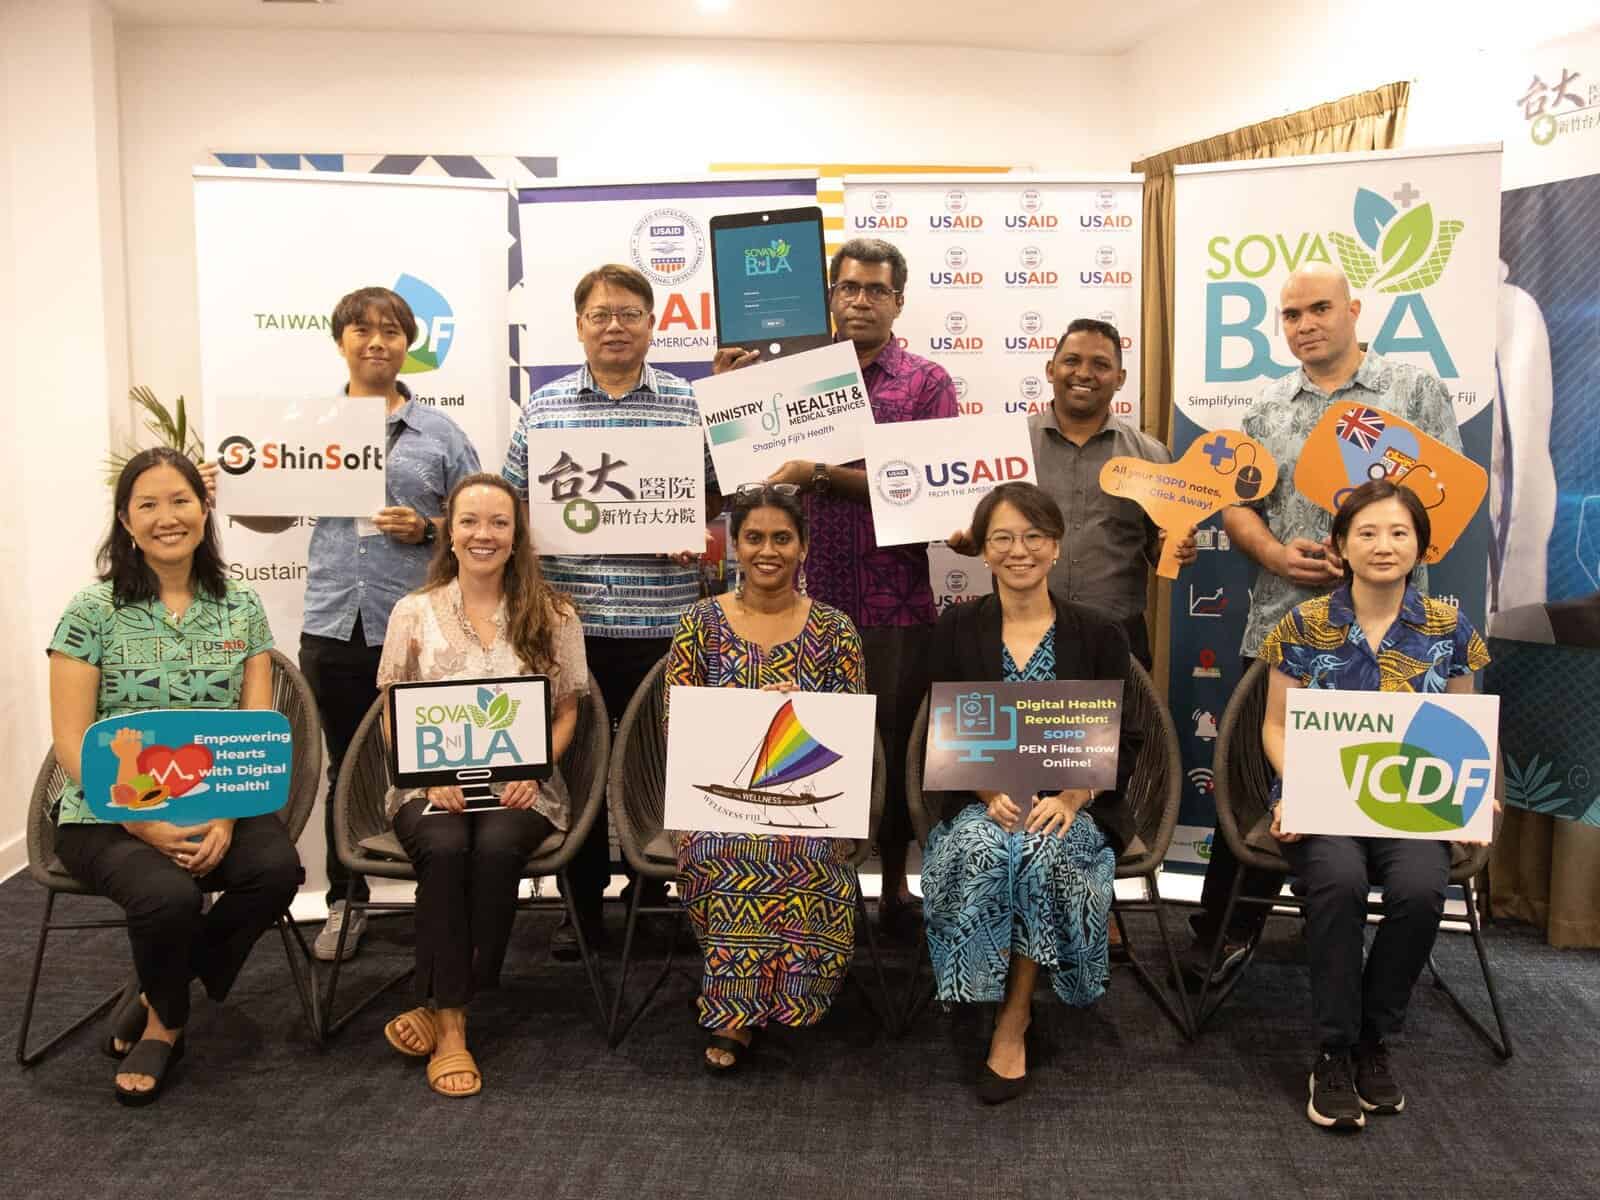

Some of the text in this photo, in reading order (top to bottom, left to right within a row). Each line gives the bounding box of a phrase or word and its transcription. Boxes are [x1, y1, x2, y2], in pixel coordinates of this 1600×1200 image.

[855, 216, 908, 228] USAID
[930, 216, 983, 228] USAID
[1005, 216, 1058, 228] USAID
[1080, 216, 1132, 228] USAID
[652, 227, 682, 235] USAID
[1206, 232, 1332, 280] SOVA
[930, 272, 983, 284] USAID
[1005, 272, 1058, 284] USAID
[1080, 272, 1132, 284] USAID
[650, 337, 709, 348] AMERICAN
[931, 337, 984, 350] USAID
[1005, 337, 1058, 350] USAID
[440, 394, 465, 406] and
[1188, 395, 1253, 408] Simplifying
[1457, 391, 1477, 405] Fiji
[705, 386, 863, 436] MINISTRY of HEALTH &
[789, 400, 866, 426] MEDICAL SERVICES
[753, 424, 835, 453] Shaping Fiji's Health
[262, 443, 383, 470] ShinSoft
[925, 456, 1029, 487] USAID
[1112, 465, 1127, 473] All
[1155, 474, 1187, 489] SOPD
[1189, 483, 1222, 498] notes,
[1178, 495, 1214, 510] Away!
[601, 507, 696, 525] 新竹台大分院
[230, 563, 308, 580] Sustain
[202, 639, 246, 650] USAID
[1016, 699, 1117, 712] Digital Health
[416, 704, 471, 725] SOVA
[1025, 714, 1109, 725] Revolution:
[1290, 710, 1394, 733] TAIWAN
[194, 731, 291, 746] Empowering
[1043, 730, 1087, 740] SOPD
[446, 735, 462, 749] NI
[216, 749, 266, 760] Hearts
[1019, 744, 1116, 754] PEN Files now
[1043, 758, 1092, 768] Online!
[199, 763, 287, 778] with Digital
[216, 780, 270, 793] Health!
[1349, 754, 1492, 806] ICDF
[743, 792, 782, 804] WELLNESS
